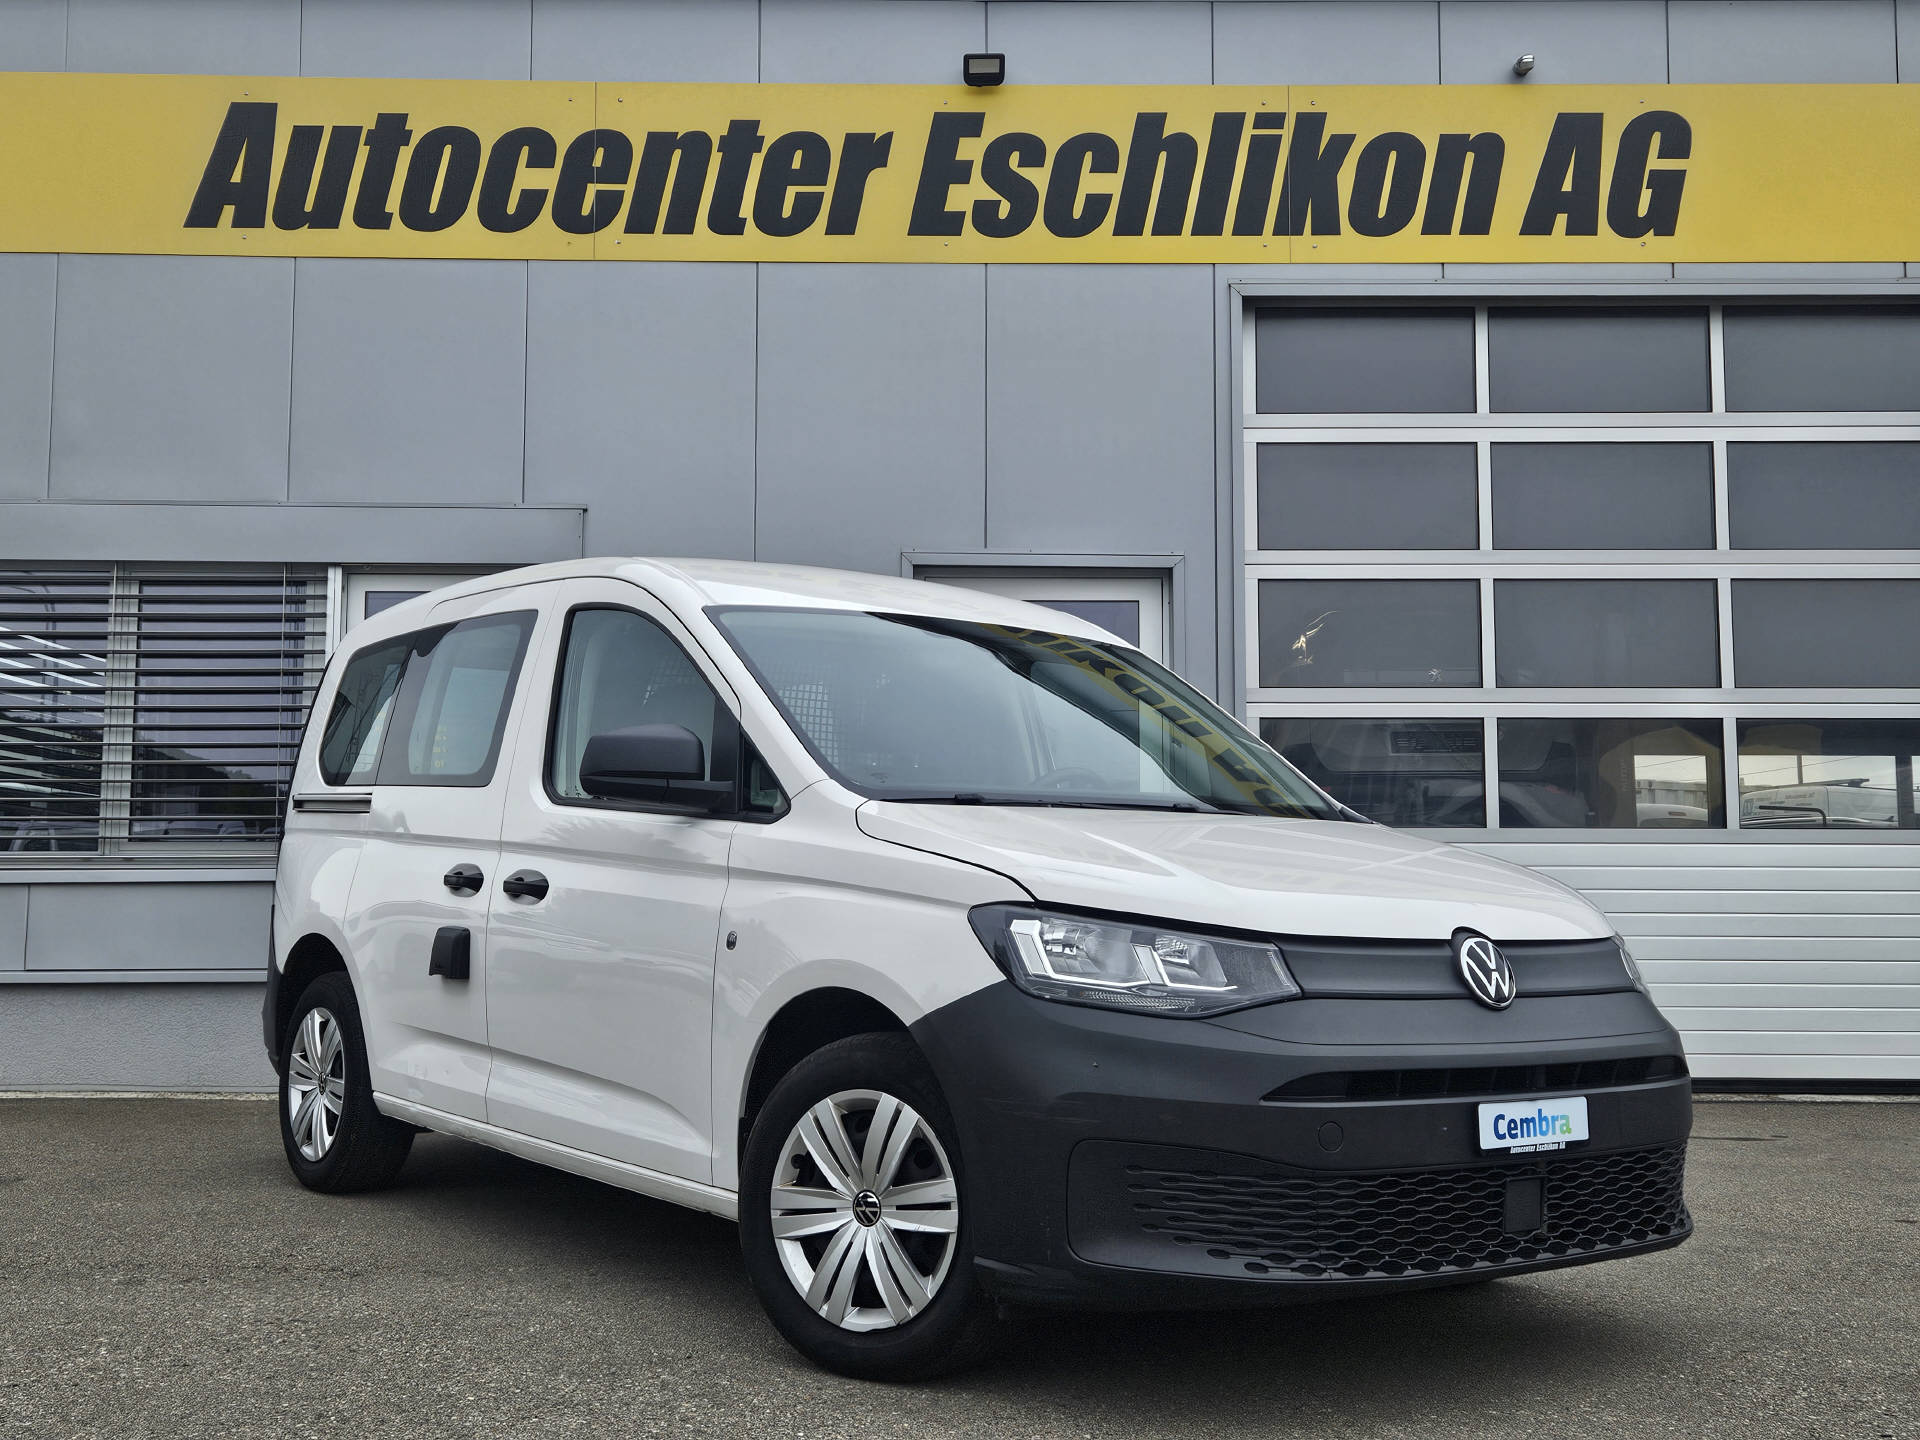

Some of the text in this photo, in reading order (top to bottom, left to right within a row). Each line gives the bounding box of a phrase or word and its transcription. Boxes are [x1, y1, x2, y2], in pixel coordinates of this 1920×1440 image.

[183, 102, 1692, 239] Autocenter Eschlikon AG
[1460, 937, 1515, 1007] VW
[1493, 1108, 1571, 1140] Cembra
